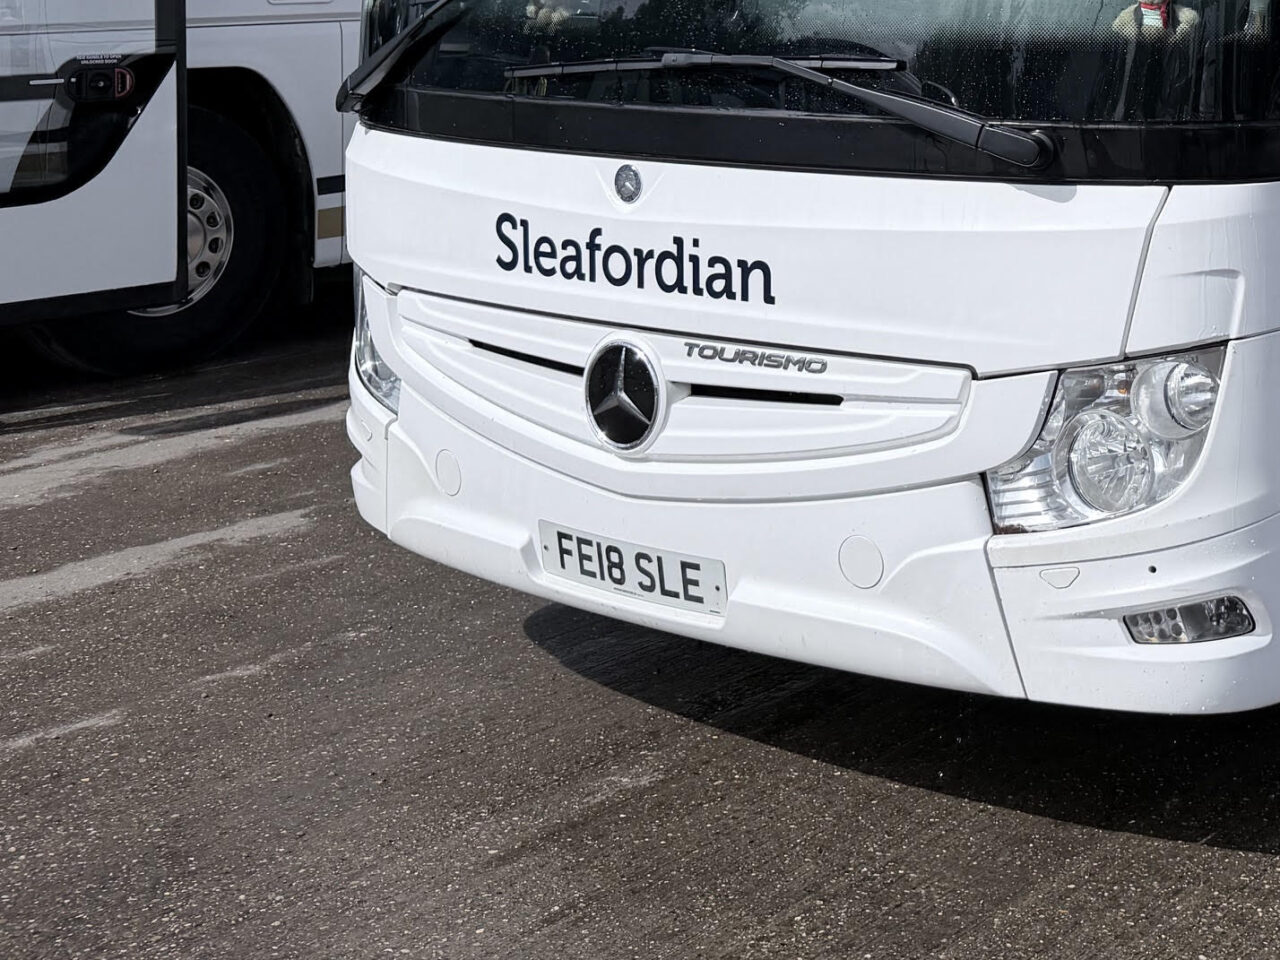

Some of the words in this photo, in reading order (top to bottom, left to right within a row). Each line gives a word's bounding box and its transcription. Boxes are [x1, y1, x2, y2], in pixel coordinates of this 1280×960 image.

[495, 212, 776, 306] Sleafordian
[684, 342, 828, 374] TOURISMO
[557, 530, 626, 586] FE18
[634, 551, 705, 605] SLE
